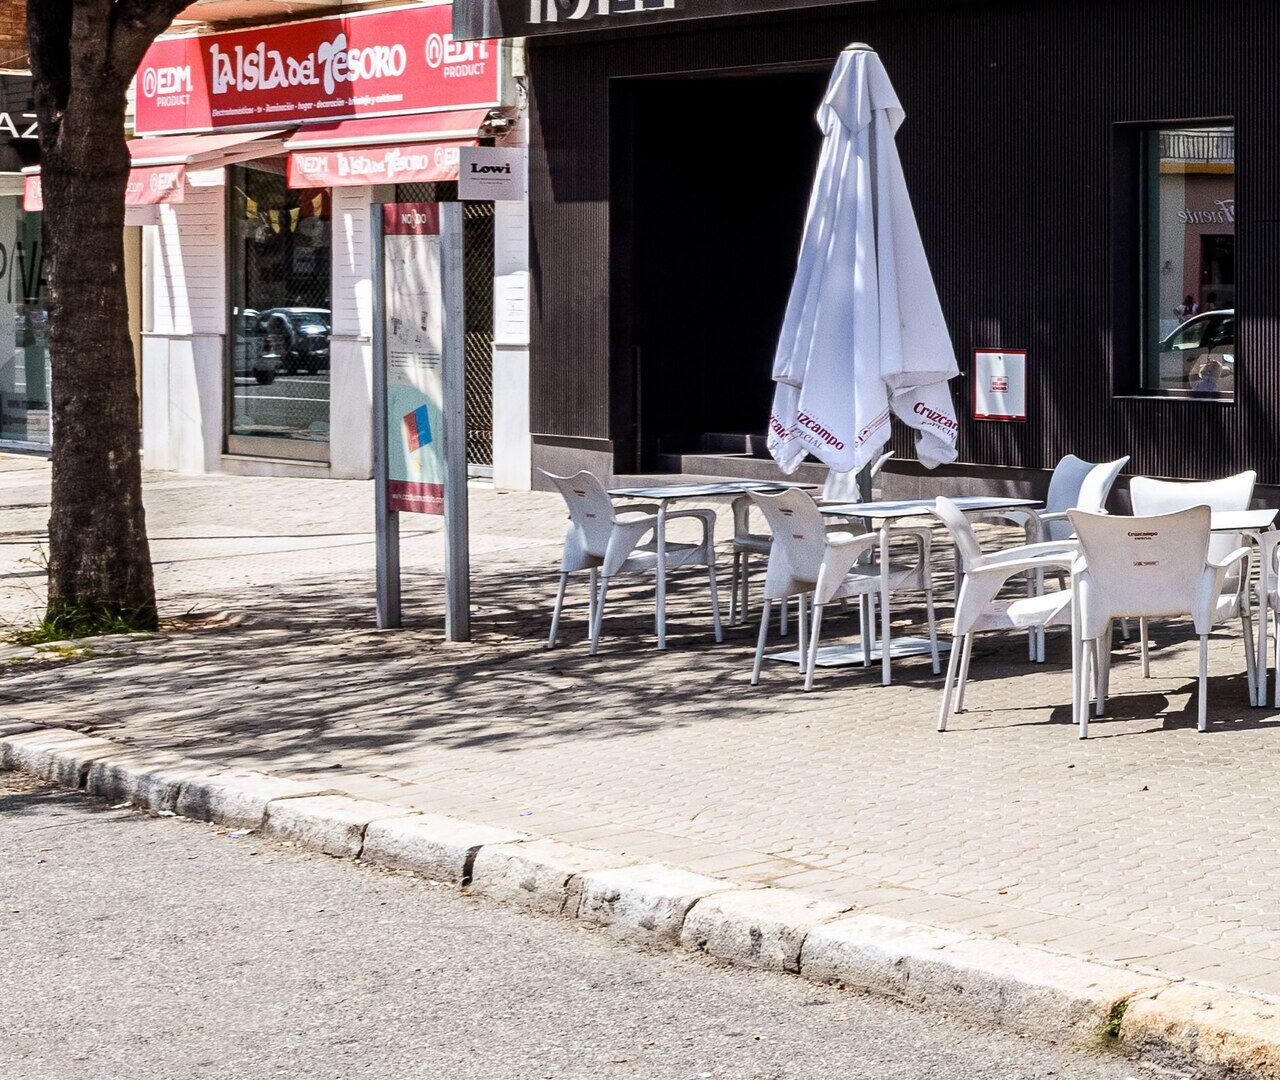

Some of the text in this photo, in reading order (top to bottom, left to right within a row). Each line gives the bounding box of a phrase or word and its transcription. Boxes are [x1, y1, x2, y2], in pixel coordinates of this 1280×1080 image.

[444, 63, 485, 78] PRODUCT
[156, 65, 193, 94] EDM
[157, 95, 190, 107] PRODUCT
[471, 163, 511, 174] Lowi
